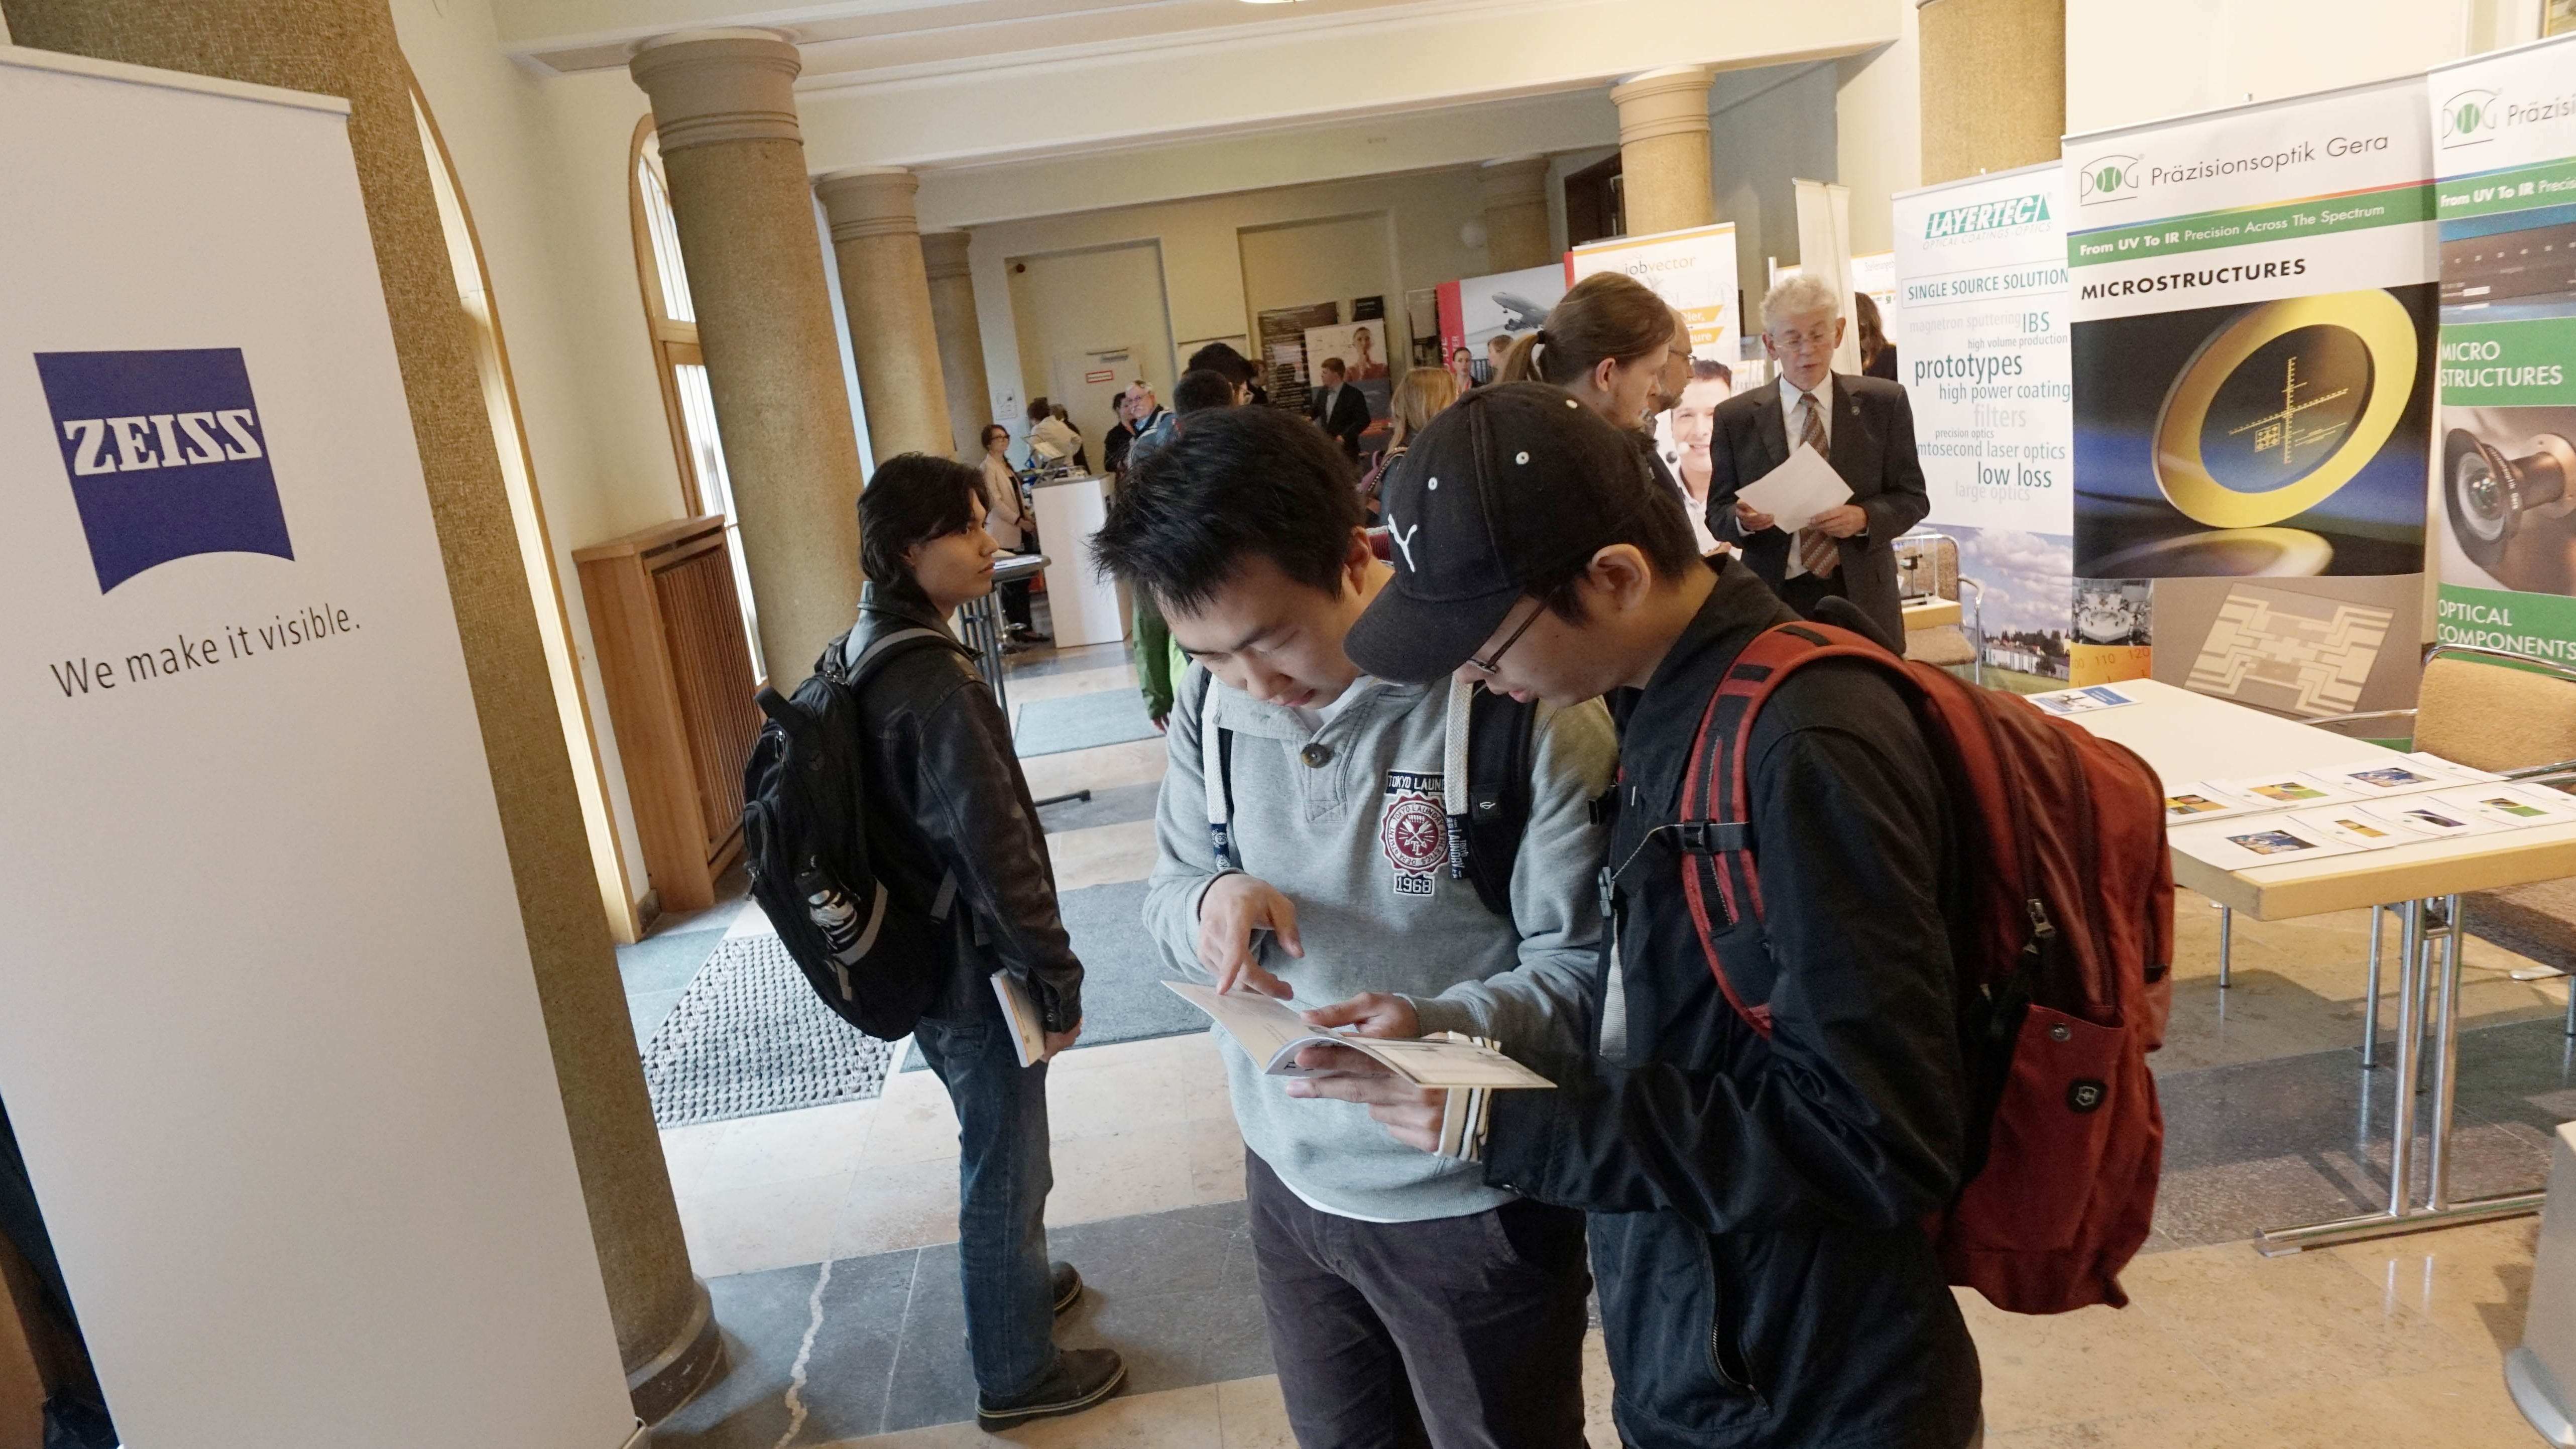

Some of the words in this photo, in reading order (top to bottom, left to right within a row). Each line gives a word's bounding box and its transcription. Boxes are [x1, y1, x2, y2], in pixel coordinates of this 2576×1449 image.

[2152, 141, 2315, 186] Präzisionsoptik
[2327, 137, 2388, 157] Gera
[2473, 187, 2495, 202] UV
[2497, 185, 2515, 199] To
[2518, 182, 2534, 196] IR
[1929, 196, 2035, 238] LAYERTEC
[2080, 243, 2113, 256] From
[2119, 237, 2140, 250] UV
[2144, 235, 2160, 247] To
[2165, 232, 2179, 244] IR
[2185, 225, 2240, 241] Precision
[2245, 219, 2287, 233] Across
[2292, 213, 2315, 226] The
[2321, 205, 2385, 224] Spectrum
[1923, 237, 1957, 250] OPTICAL
[1625, 257, 1696, 275] jobvector
[1908, 282, 1947, 300] SINGLE
[1952, 276, 1999, 295] SOURCE
[2081, 258, 2306, 300] MICROSTRUCTURES
[1909, 318, 1963, 335] magnetron
[1966, 311, 2021, 330] sputtering
[2023, 312, 2050, 333] IBS
[1967, 338, 1984, 351] high
[1987, 337, 2017, 348] volume
[2019, 334, 2068, 348] production
[2441, 341, 2501, 361] MICRO
[1915, 353, 2022, 387] prototypes
[2441, 366, 2563, 388] STRUCTURES
[1939, 383, 1966, 404] high
[1972, 385, 2013, 403] power
[1974, 404, 2027, 427] filters
[62, 408, 263, 476] ZEISS
[1935, 429, 1969, 440] precision
[1971, 429, 1995, 440] optics
[1987, 441, 2019, 458] laser
[2024, 442, 2066, 463] optics
[1978, 461, 2010, 485] low
[2018, 462, 2052, 488] loss
[1955, 481, 1985, 503] large
[1990, 483, 2031, 504] optics
[2438, 599, 2513, 627] OPTICAL
[50, 657, 116, 698] We
[126, 634, 221, 683] make
[225, 625, 255, 658] it
[259, 602, 361, 652] visible.
[2437, 623, 2576, 660] COMPONENTS
[2095, 653, 2115, 665] 110
[2128, 647, 2150, 659] 120
[1388, 775, 1411, 788] TOKYO
[1393, 805, 1411, 822] TOKYO
[1412, 805, 1444, 826] LAUNDRY
[1448, 829, 1465, 868] LAUNDRY
[1396, 878, 1432, 894] 1968
